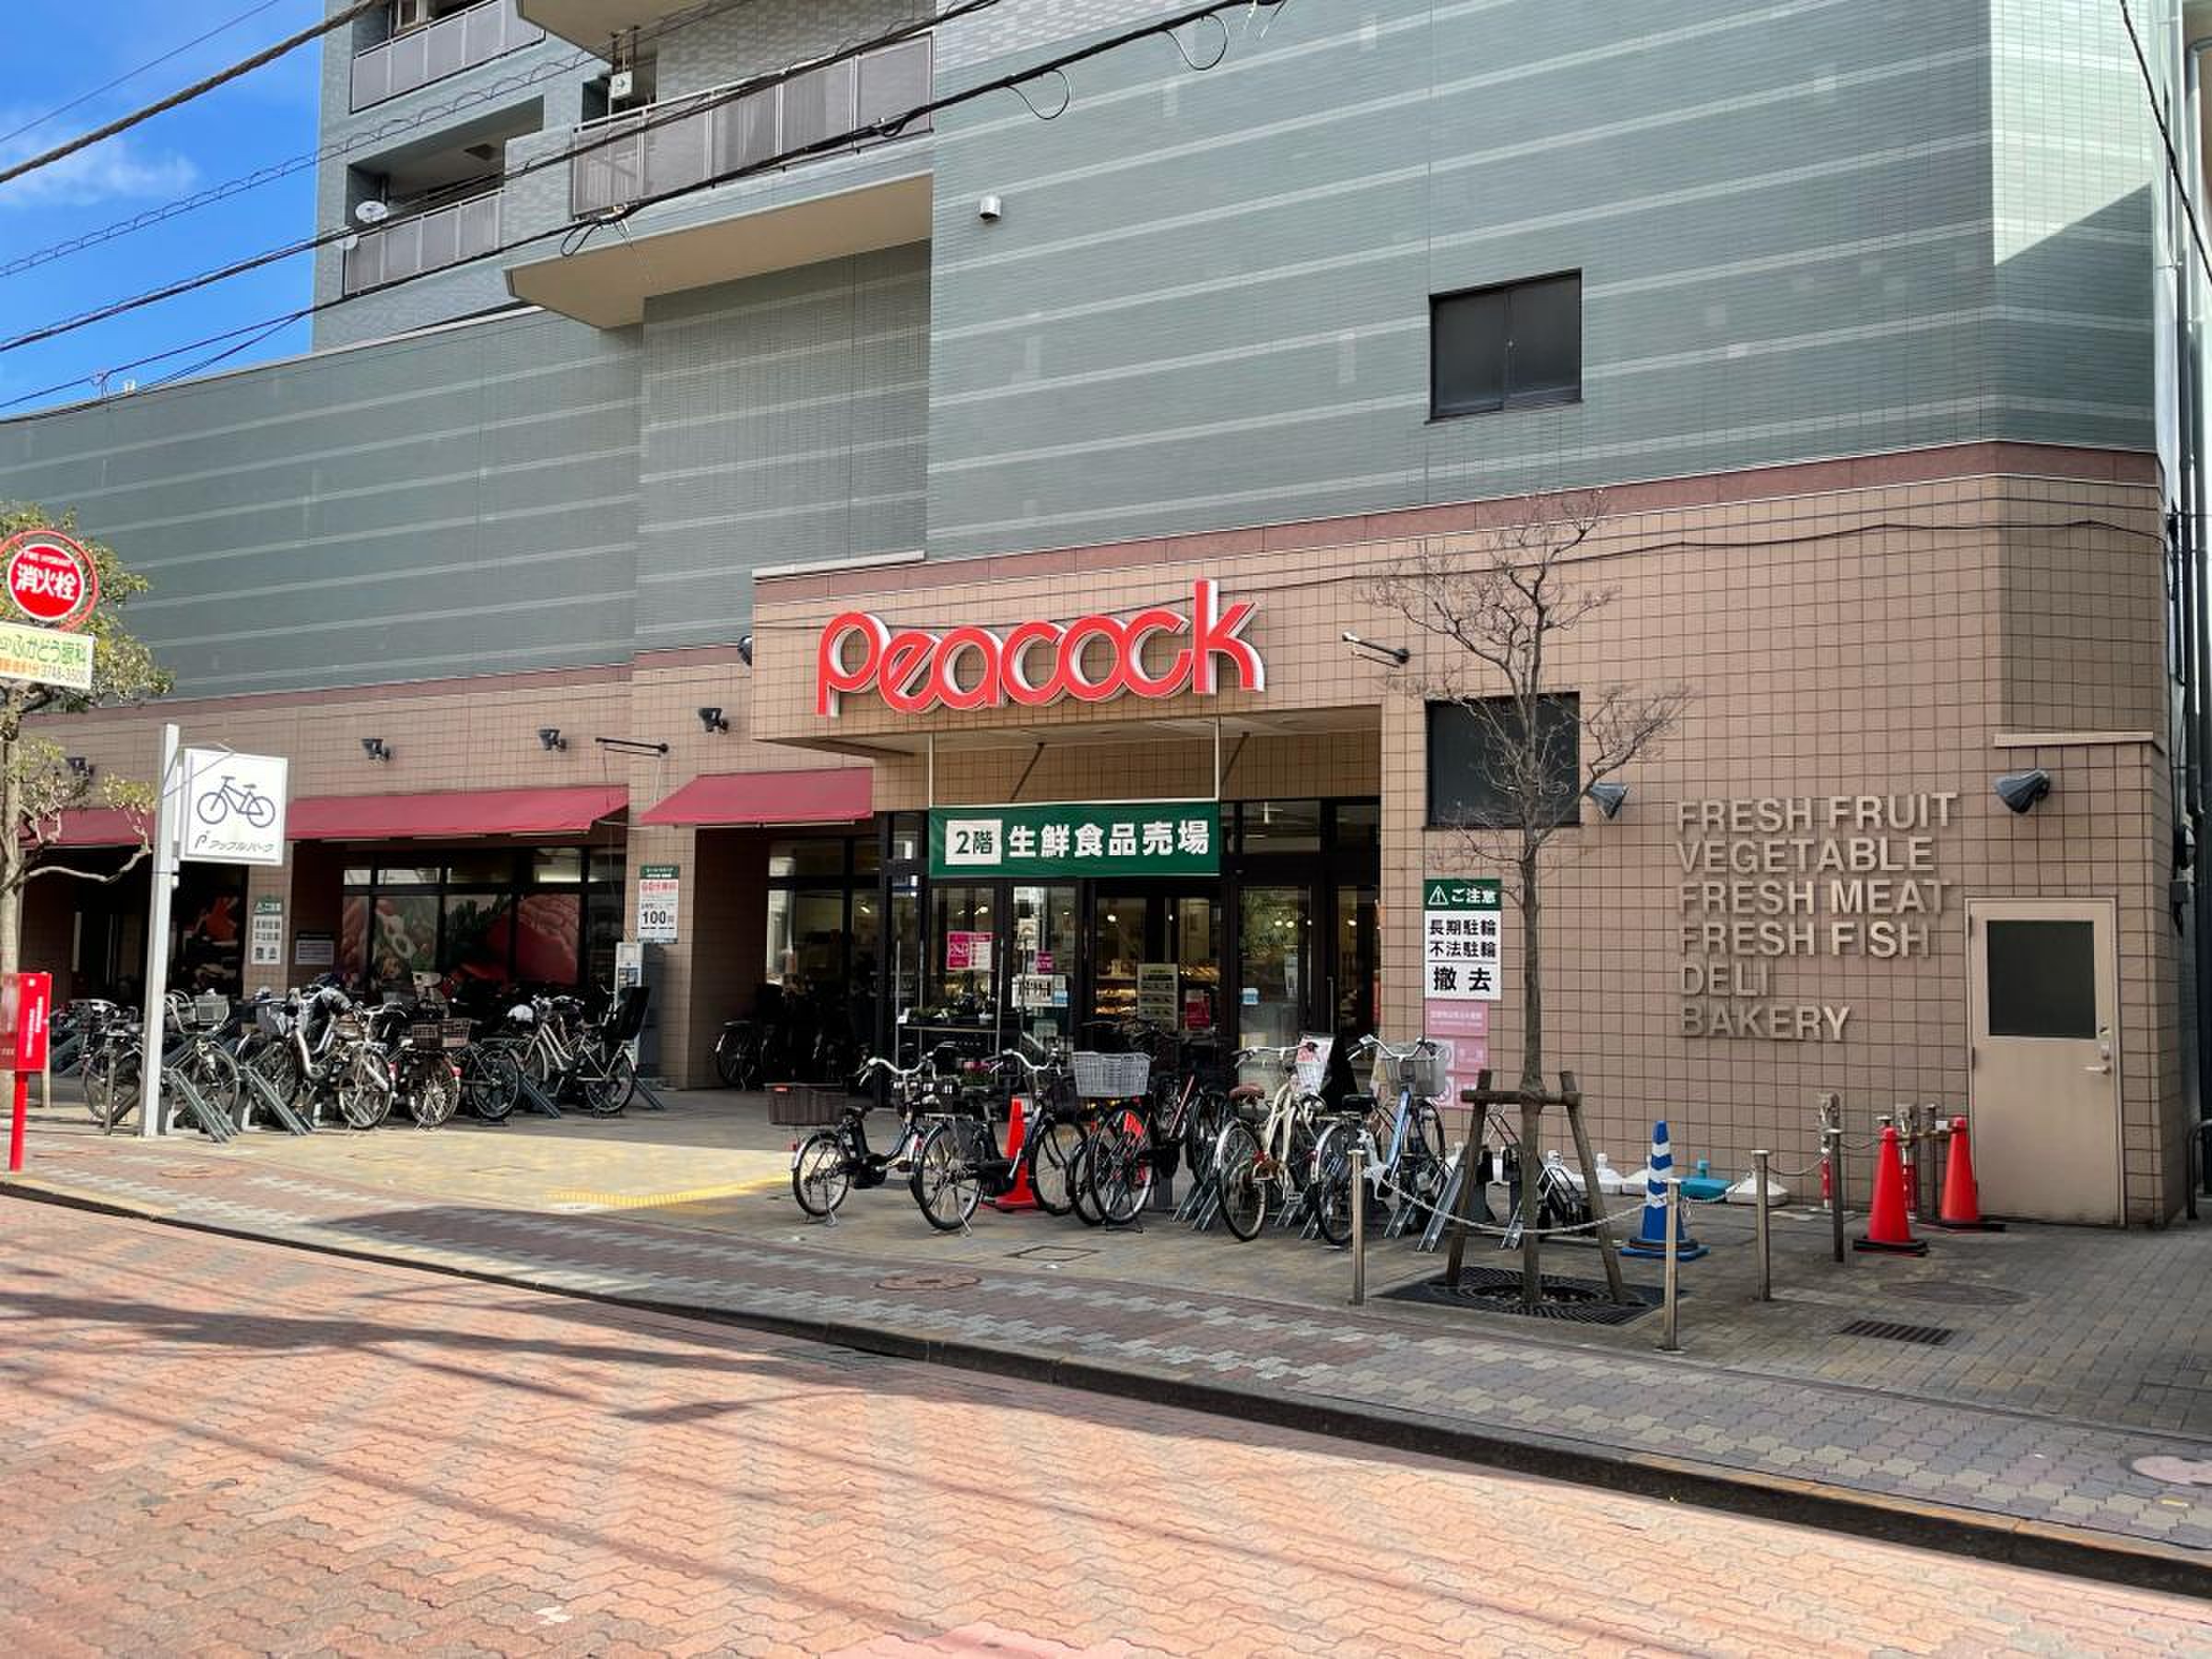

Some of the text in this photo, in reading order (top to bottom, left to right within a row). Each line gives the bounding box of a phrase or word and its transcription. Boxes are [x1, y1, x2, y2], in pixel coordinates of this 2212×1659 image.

[15, 562, 77, 600] 消火栓
[1677, 792, 1958, 831] FRESH FRUIT
[955, 831, 993, 855] 2階
[1007, 819, 1210, 859] 生鮮食品売場
[1676, 836, 1935, 874] VEGETABLE
[1451, 888, 1497, 904] ご注意
[1678, 878, 1950, 915] FRESH MEAT
[1430, 919, 1496, 936] 長期駐輪
[1680, 922, 1930, 958] FRESH FISH
[1430, 940, 1496, 959] 不法駐輪
[1433, 967, 1492, 992] 撤去
[1679, 962, 1769, 996] DELI
[1680, 1006, 1851, 1041] BAKERY
